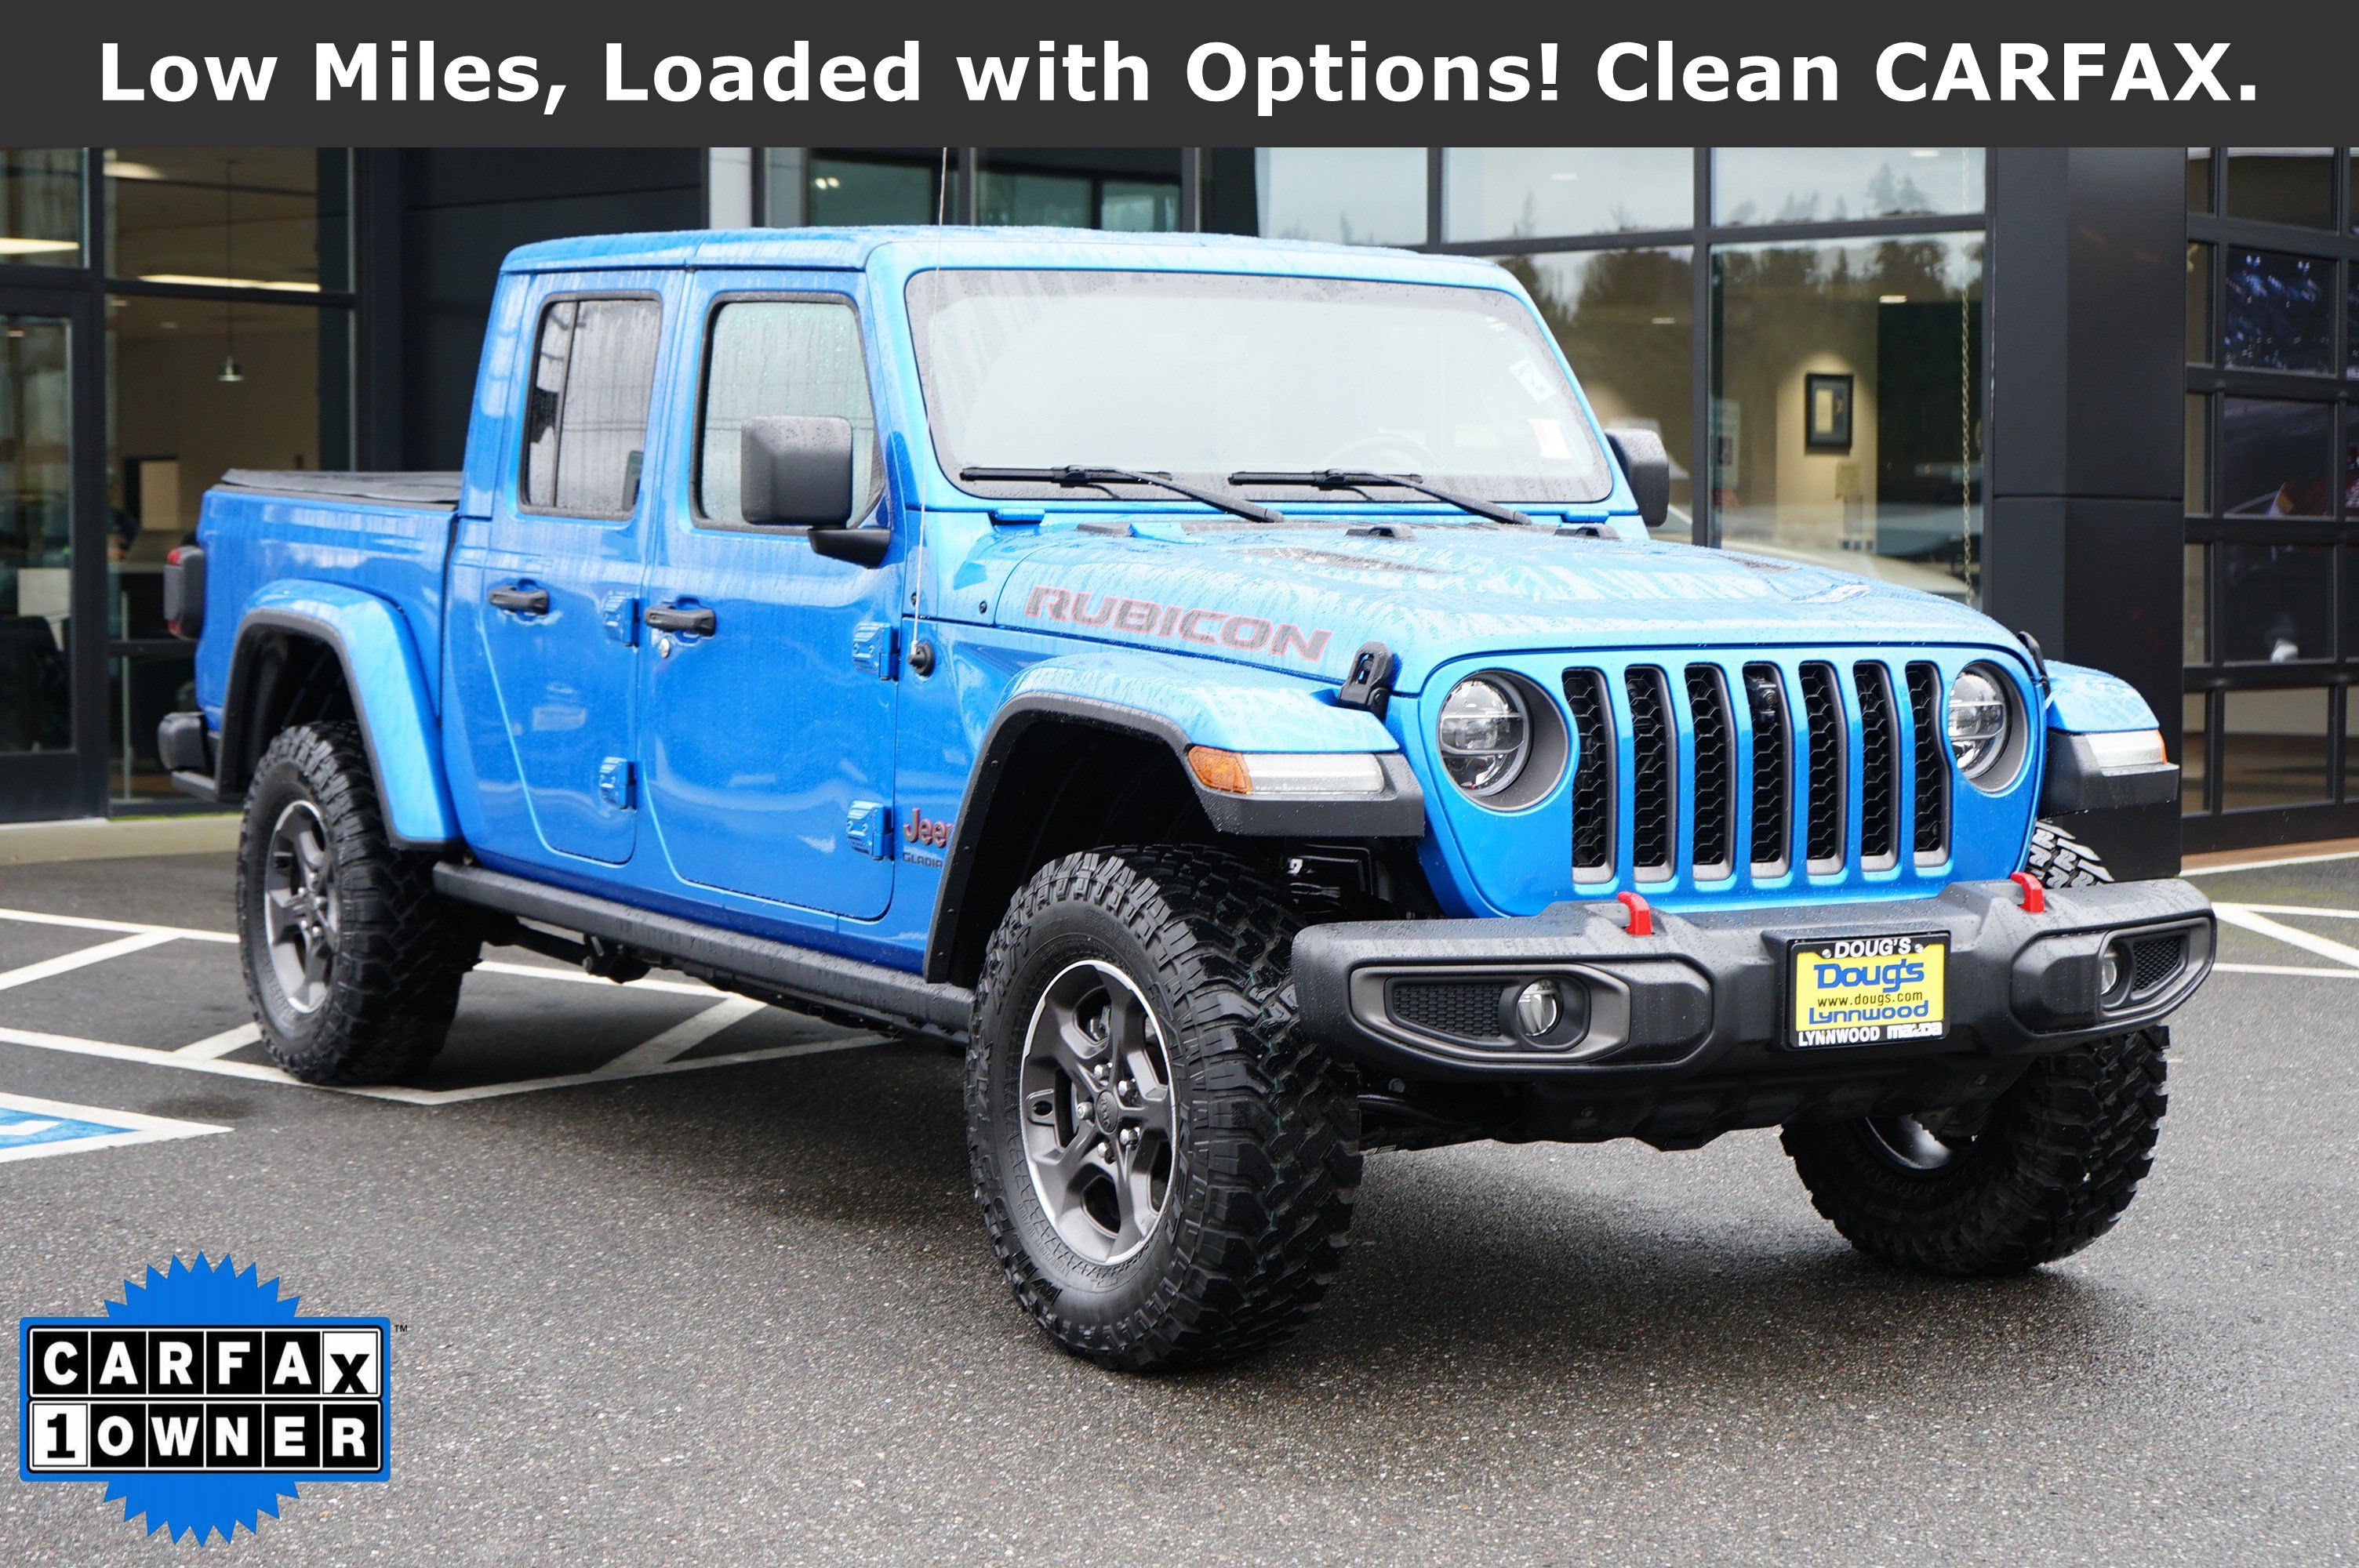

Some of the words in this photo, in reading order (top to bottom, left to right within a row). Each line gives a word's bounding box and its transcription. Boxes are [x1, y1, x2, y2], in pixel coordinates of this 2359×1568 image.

[1024, 584, 1332, 662] RUBICON
[1834, 937, 1912, 959] DOUG'S
[1813, 958, 1925, 993] Doug's
[1817, 990, 1923, 1007] www.dougs.com
[1808, 1000, 1928, 1025] Lynnwood
[1798, 1025, 1881, 1047] LYNNWOOD
